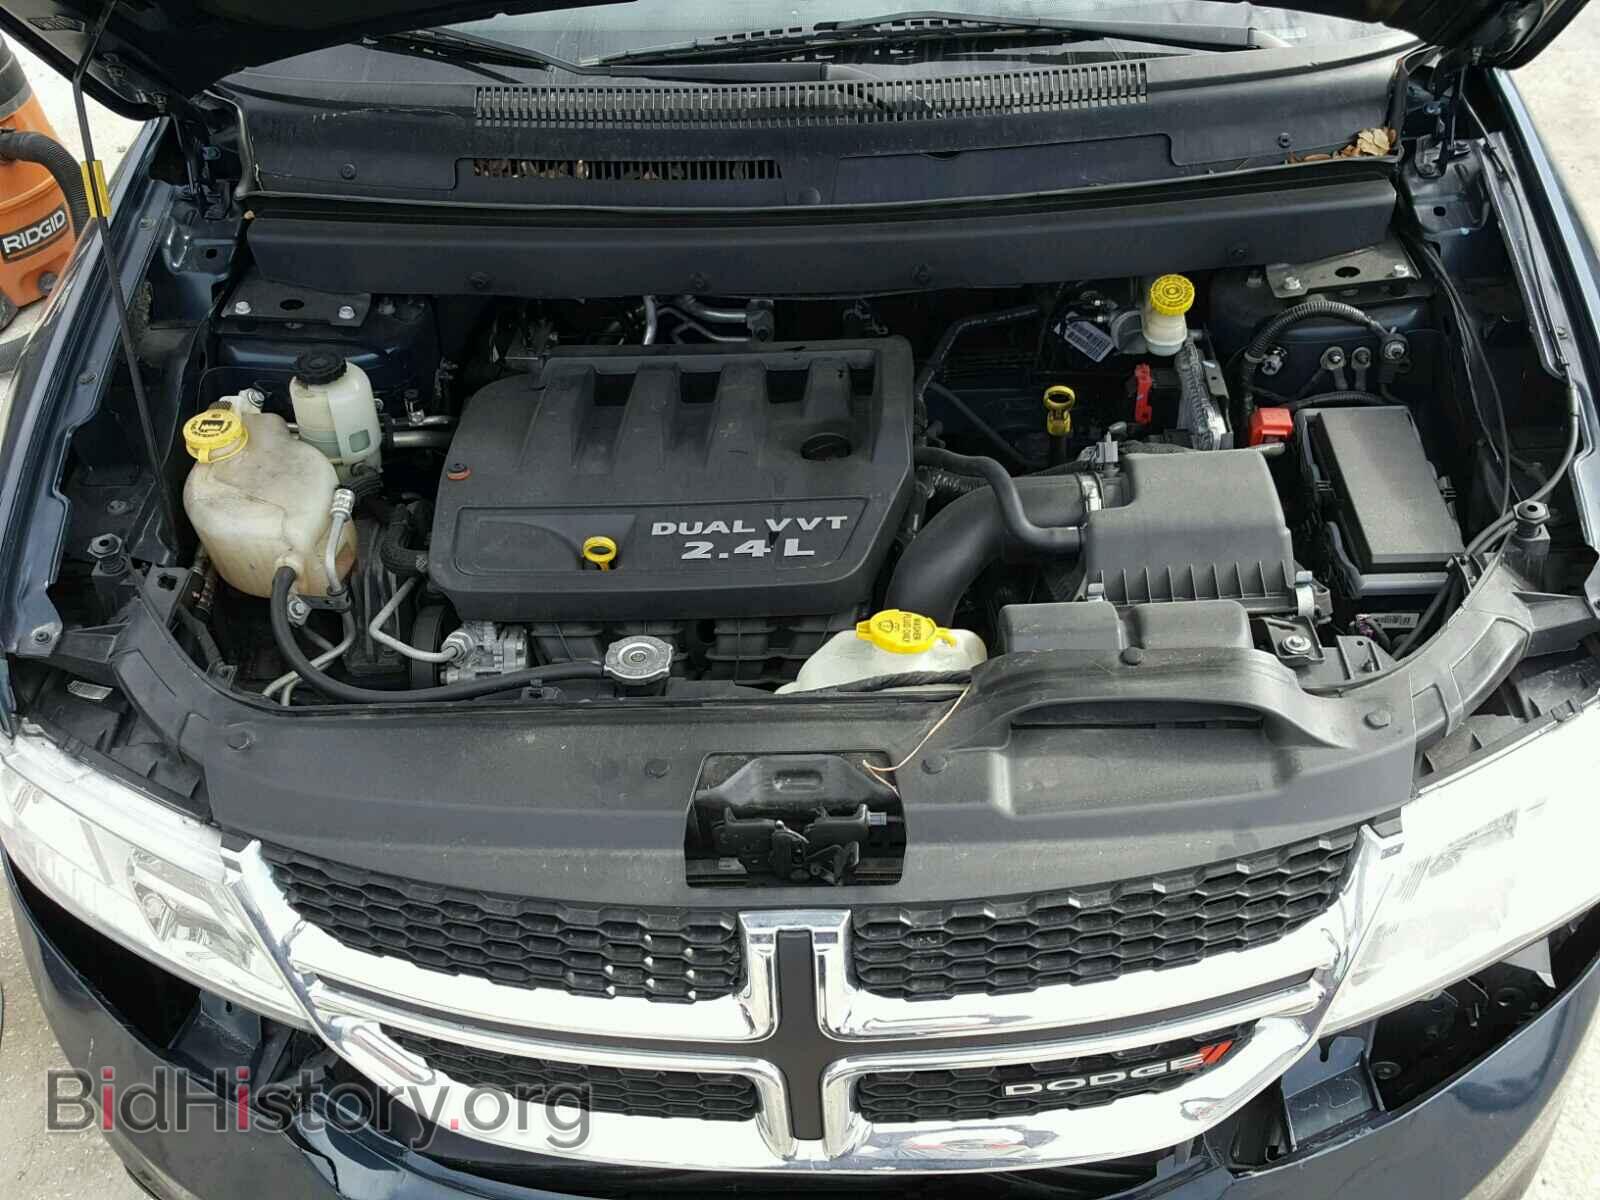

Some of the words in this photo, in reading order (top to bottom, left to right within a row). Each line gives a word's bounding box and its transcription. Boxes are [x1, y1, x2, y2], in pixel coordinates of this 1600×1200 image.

[2, 210, 66, 253] RIDGID
[651, 520, 756, 535] DUAL
[765, 516, 848, 532] VVT
[1005, 1054, 1204, 1096] DODGE
